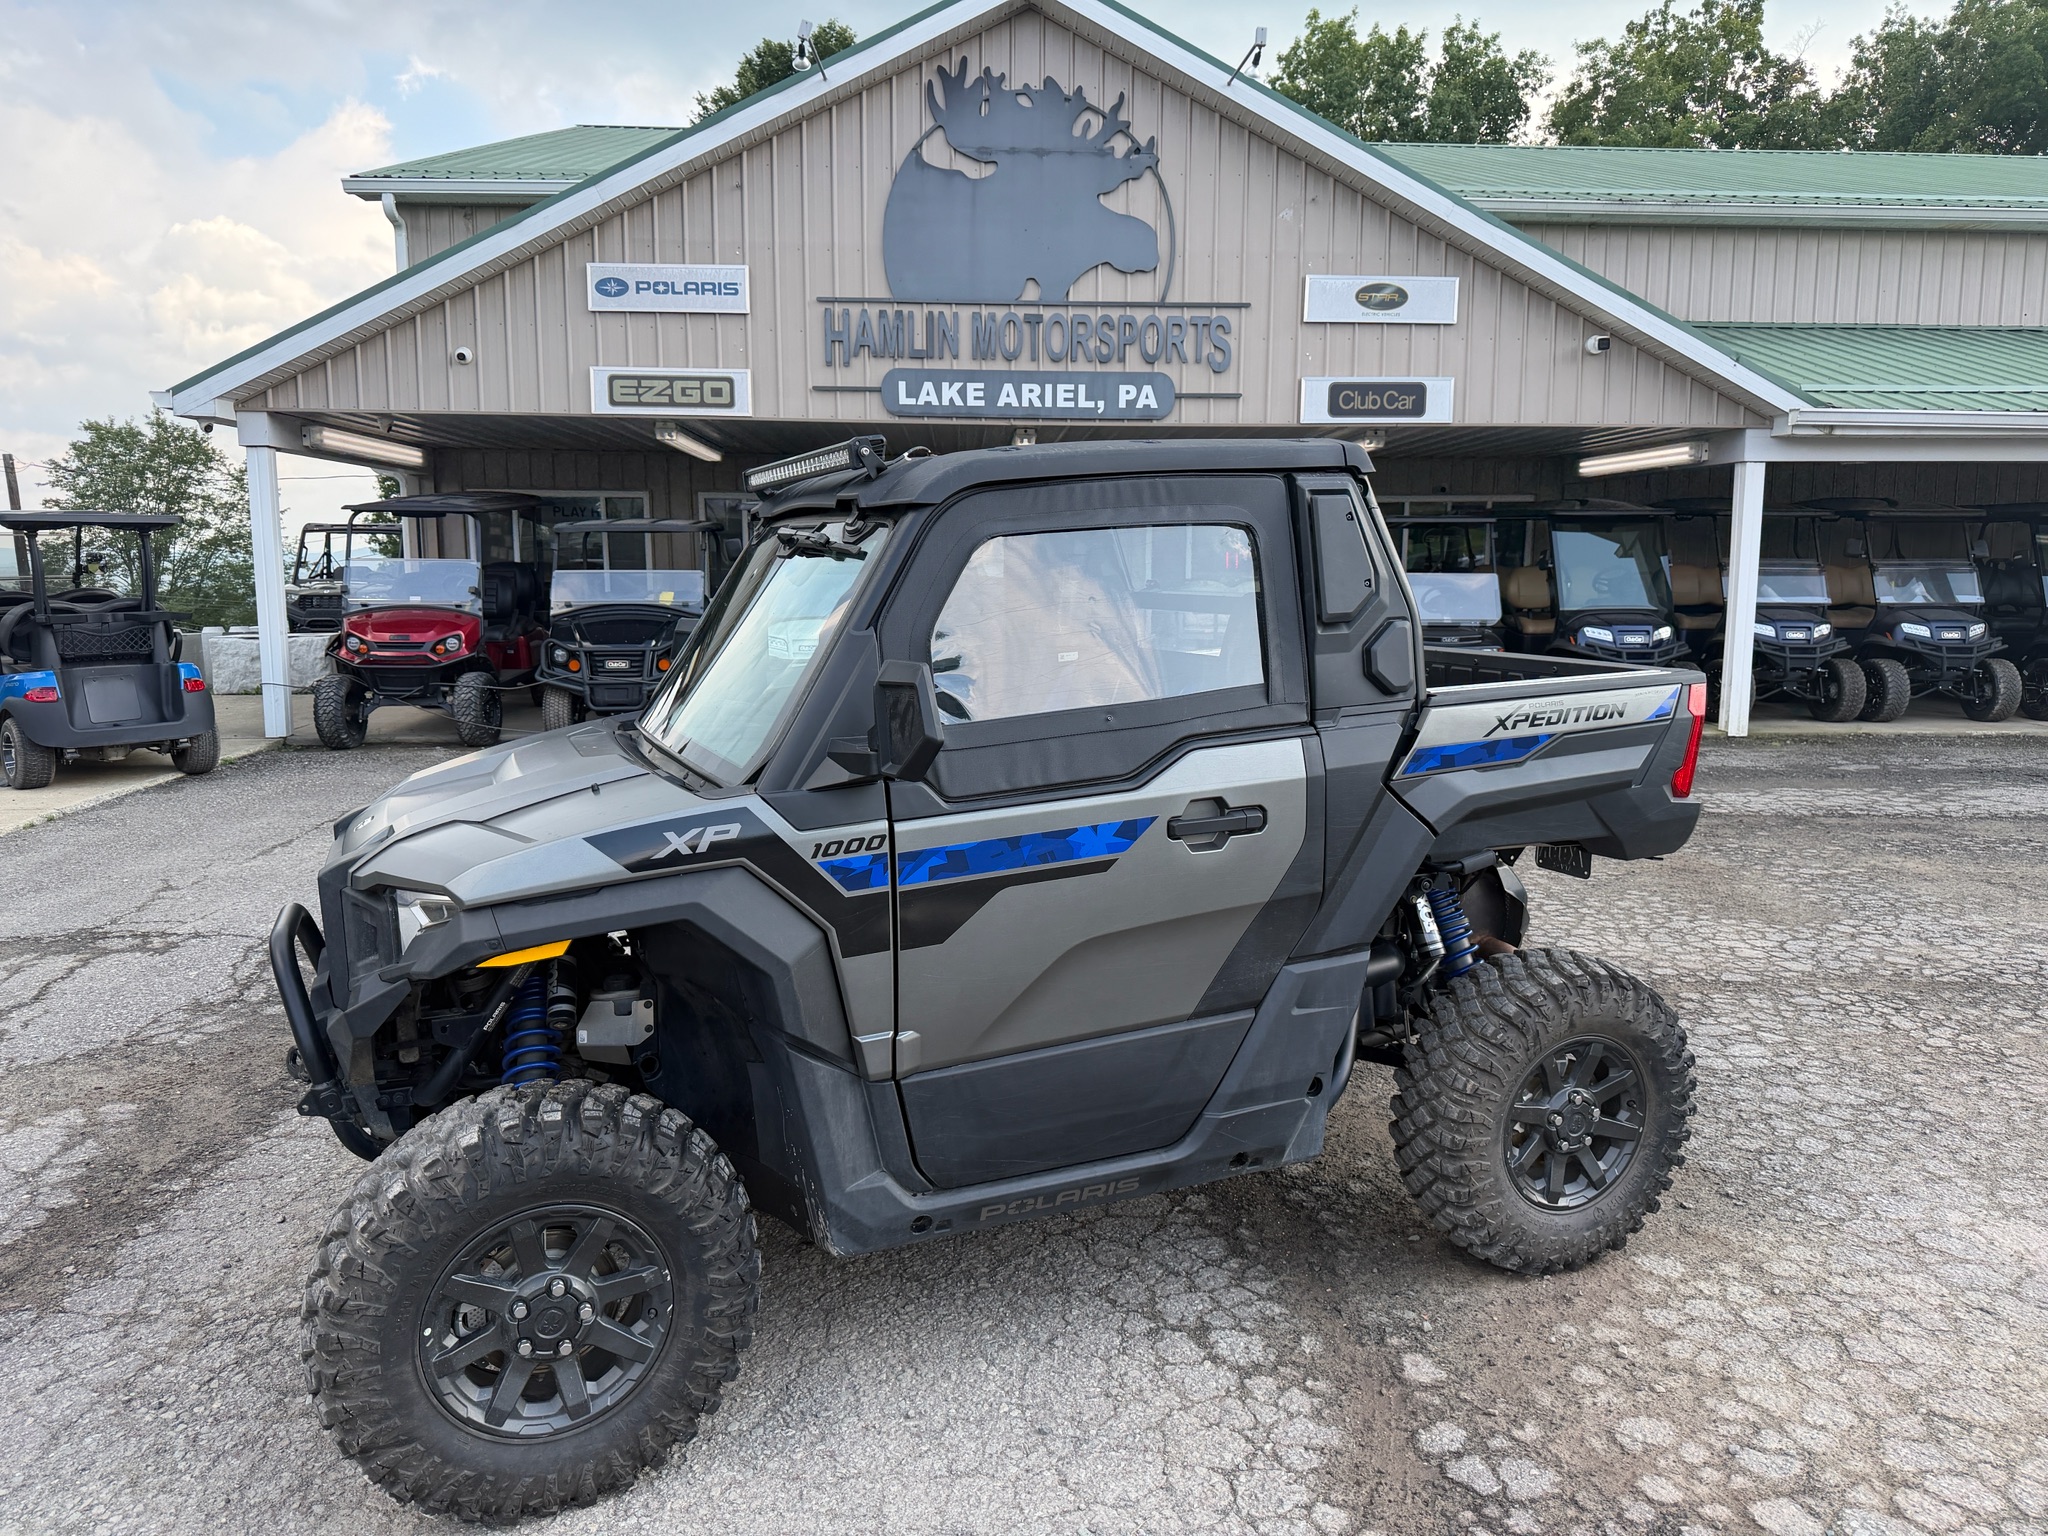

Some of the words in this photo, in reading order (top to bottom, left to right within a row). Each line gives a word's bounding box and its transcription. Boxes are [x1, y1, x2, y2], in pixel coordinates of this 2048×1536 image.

[635, 280, 739, 296] POLARIS
[1358, 292, 1399, 302] STAR
[824, 307, 958, 367] HAMLIN
[971, 312, 1232, 373] MOTORSPORTS
[898, 381, 985, 407] LAKE
[997, 382, 1105, 414] ARIEL,
[1118, 385, 1158, 409] PA
[1338, 390, 1381, 410] Club
[1383, 390, 1416, 410] Car
[553, 506, 587, 518] PLAY
[1528, 700, 1564, 709] POLARIS
[1483, 702, 1627, 738] XPEDITION
[650, 822, 742, 860] XP
[811, 833, 887, 860] 1000
[483, 1001, 506, 1031] POLARIS
[980, 1177, 1139, 1221] POLARIS
